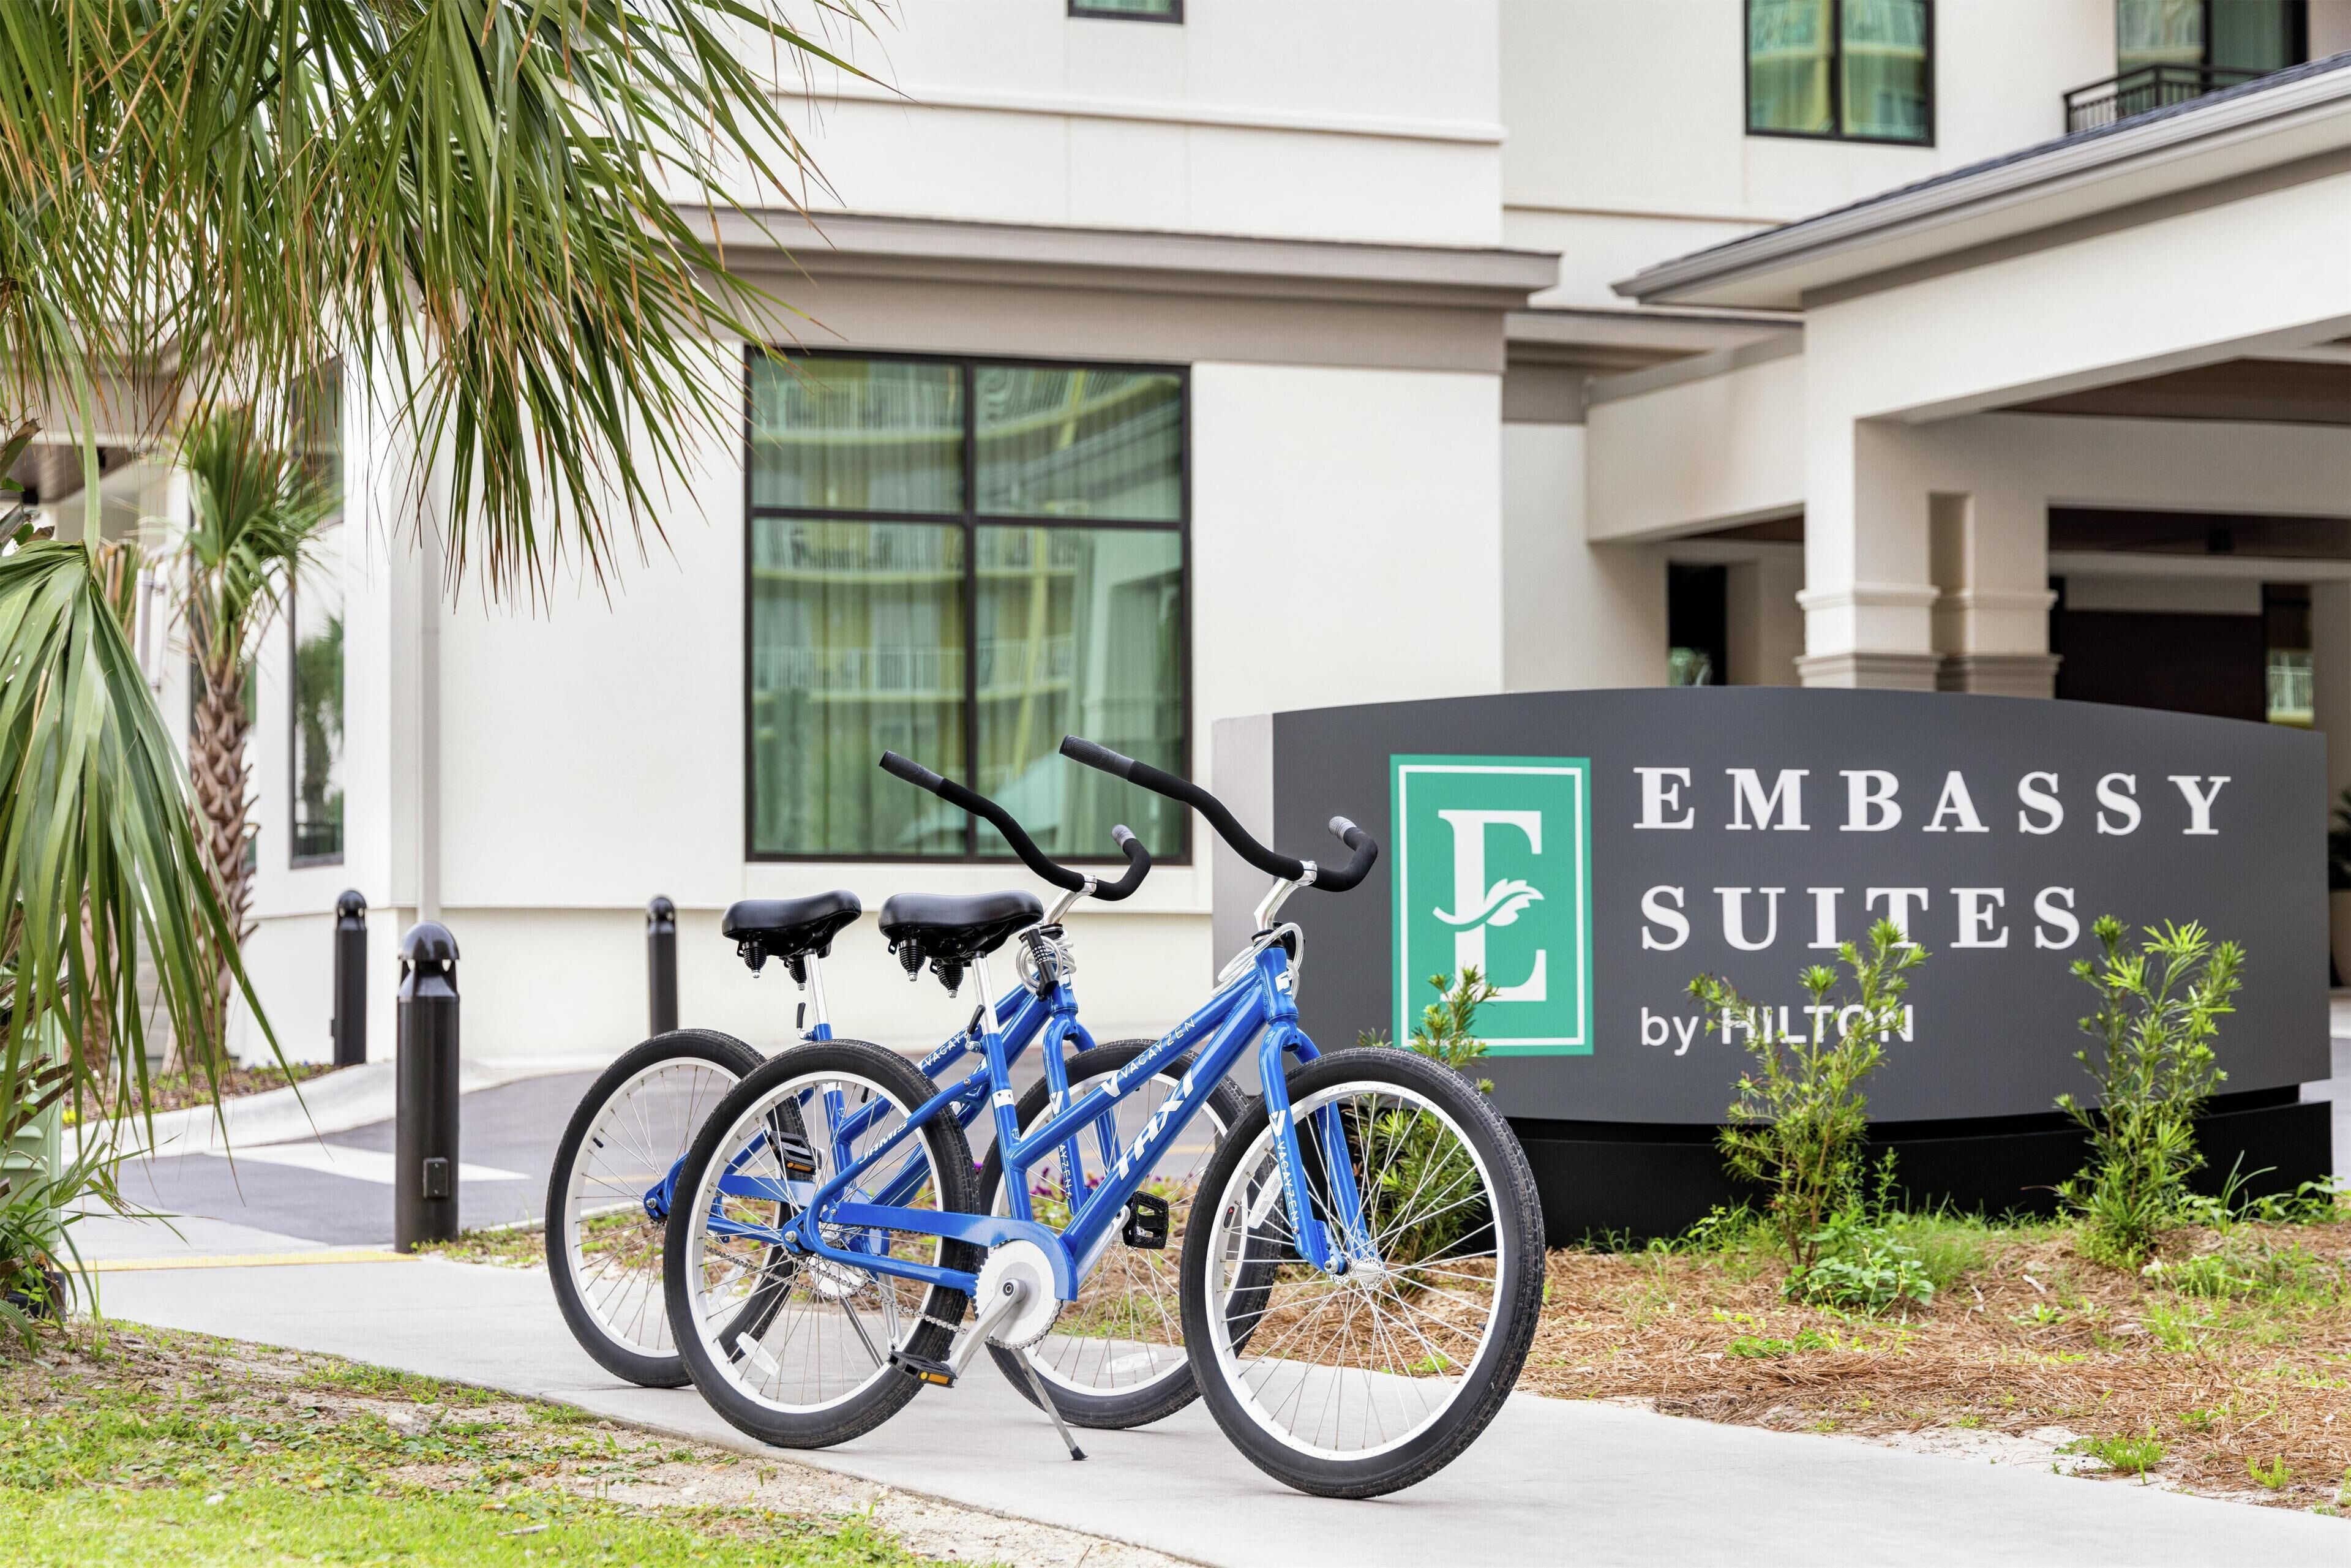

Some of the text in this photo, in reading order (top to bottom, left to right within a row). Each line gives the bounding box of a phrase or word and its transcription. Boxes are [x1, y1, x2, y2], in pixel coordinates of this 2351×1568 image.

[1633, 767, 2231, 836] EMBASSY
[1641, 885, 2080, 951] SUITES
[924, 1027, 978, 1067] VACAY
[1120, 1018, 1196, 1079] VACAYZEN
[1641, 1004, 1914, 1056] by HILTON
[858, 1119, 908, 1165] JAMIS
[1112, 1068, 1194, 1181] TAXI
[1059, 1144, 1073, 1189] AYZEN
[1277, 1140, 1300, 1222] VACAYZEN
